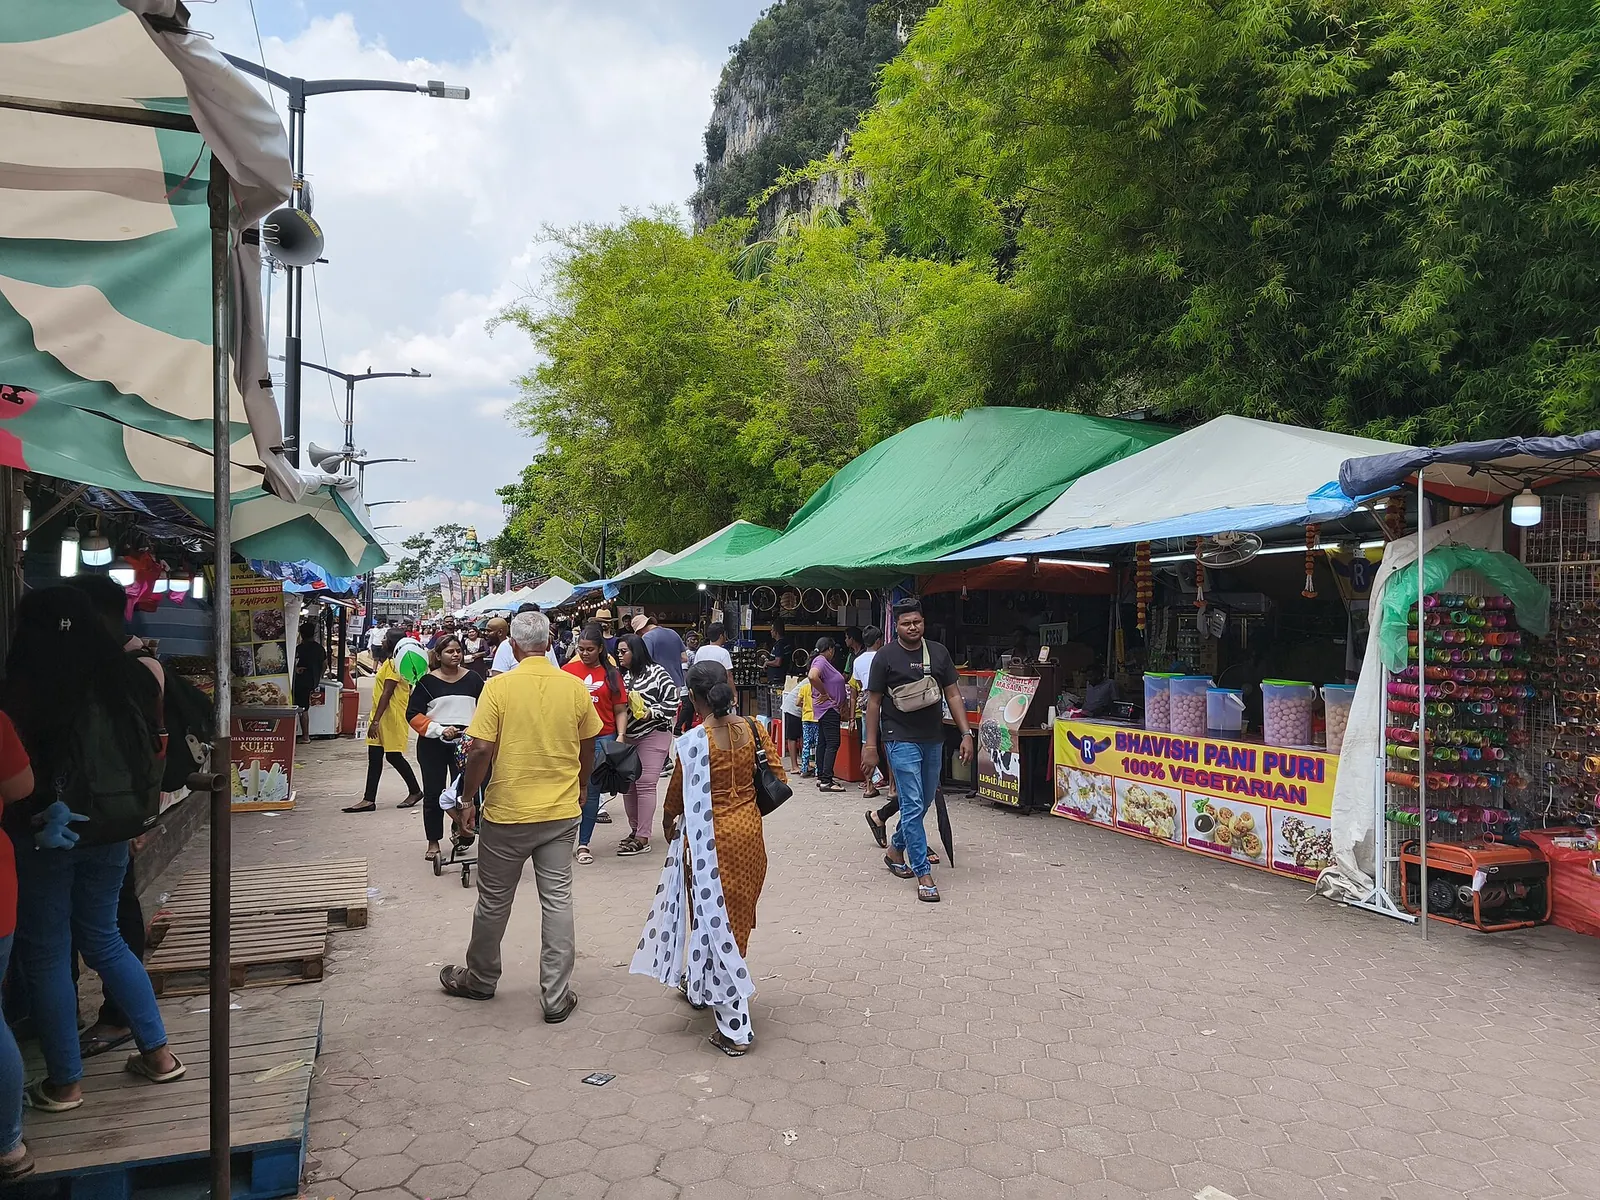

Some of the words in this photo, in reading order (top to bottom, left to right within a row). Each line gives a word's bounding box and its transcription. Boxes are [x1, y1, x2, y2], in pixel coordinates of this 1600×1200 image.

[1354, 563, 1365, 586] R
[996, 681, 1022, 692] MASALA
[1024, 686, 1035, 694] TEA
[1083, 739, 1091, 759] R
[1115, 731, 1199, 764] BHAVISH
[1203, 745, 1257, 774] PANI
[1263, 752, 1325, 784] PURI
[1121, 757, 1166, 780] 100%
[1169, 765, 1308, 806] VEGETARIAN
